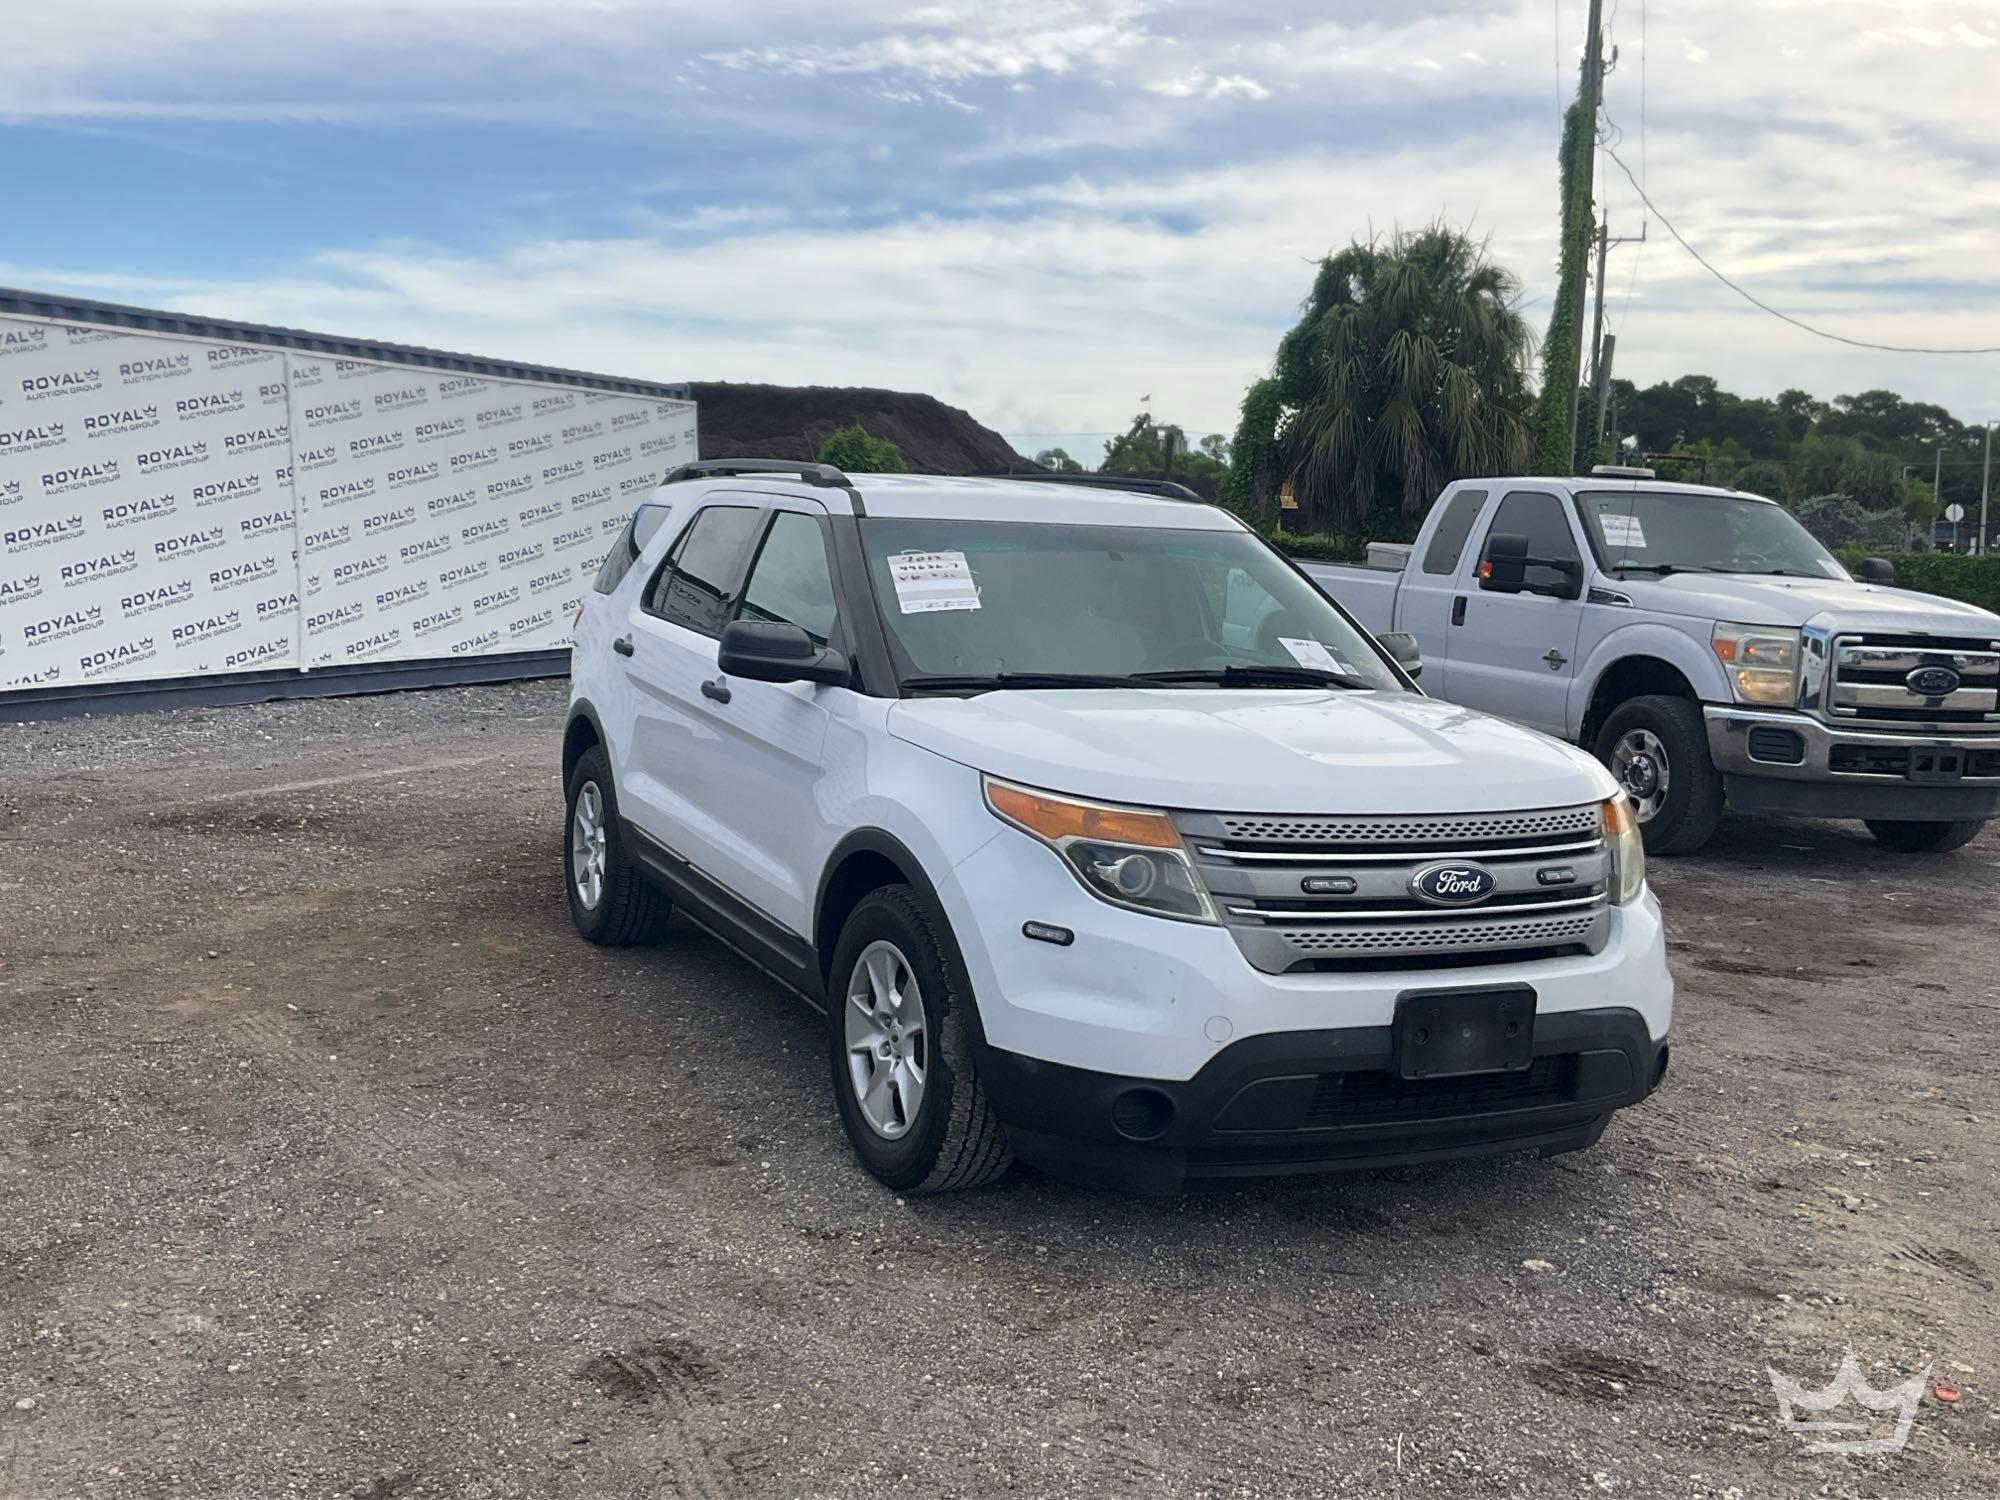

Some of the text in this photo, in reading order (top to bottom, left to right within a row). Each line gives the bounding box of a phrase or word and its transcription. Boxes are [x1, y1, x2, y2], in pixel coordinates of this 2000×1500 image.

[12, 344, 46, 354] GROUP
[120, 358, 176, 376] ROYAL
[22, 373, 84, 392] ROYAL
[124, 368, 192, 385] AUCTION GROUP
[440, 378, 477, 392] ROYAL
[26, 383, 102, 401] AUCTION GROUP
[376, 390, 416, 405] ROYAL
[177, 394, 230, 412] ROYAL
[180, 403, 245, 420] AUCTION GROUP
[305, 403, 350, 419] ROYAL
[533, 396, 566, 409] ROYAL
[85, 410, 143, 429] ROYAL
[477, 408, 512, 422] ROYAL
[612, 412, 641, 425] ROYAL
[89, 420, 160, 438] AUCTION GROUP
[416, 420, 455, 436] ROYAL
[563, 424, 594, 438] ROYAL
[33, 438, 66, 449] GROUP
[225, 429, 275, 447] ROYAL
[228, 438, 290, 455] AUCTION GROUP
[350, 434, 392, 451] ROYAL
[510, 436, 543, 451] ROYAL
[641, 437, 668, 451] ROYAL
[138, 446, 193, 466] ROYAL
[142, 455, 209, 474] AUCTION GROUP
[452, 450, 488, 466] ROYAL
[594, 450, 623, 464] ROYAL
[42, 465, 103, 486] ROYAL
[389, 465, 428, 482] ROYAL
[543, 463, 575, 478] ROYAL
[46, 474, 120, 495] AUCTION GROUP
[194, 479, 246, 499] ROYAL
[320, 481, 363, 499] ROYAL
[488, 478, 523, 493] ROYAL
[621, 475, 649, 490] ROYAL
[197, 487, 260, 507] AUCTION GROUP
[429, 493, 466, 510] ROYAL
[572, 489, 603, 504] ROYAL
[104, 499, 161, 520] ROYAL
[107, 507, 177, 529] AUCTION GROUP
[520, 504, 553, 520] ROYAL
[241, 511, 290, 531] ROYAL
[364, 510, 405, 528] ROYAL
[4, 521, 67, 544] ROYAL
[244, 526, 278, 539] AUCTION
[463, 521, 499, 538] ROYAL
[553, 529, 585, 545] ROYAL
[8, 530, 85, 553] AUCTION GROUP
[156, 532, 210, 554] ROYAL
[401, 539, 440, 557] ROYAL
[160, 540, 225, 562] AUCTION GROUP
[499, 546, 533, 563] ROYAL
[62, 555, 122, 578] ROYAL
[66, 563, 138, 588] AUCTION GROUP
[210, 562, 261, 584] ROYAL
[334, 558, 376, 578] ROYAL
[441, 564, 478, 583] ROYAL
[214, 569, 276, 592] AUCTION GROUP
[530, 571, 563, 588] ROYAL
[8, 589, 42, 603] GROUP
[122, 586, 178, 609] ROYAL
[377, 584, 417, 604] ROYAL
[475, 590, 510, 609] ROYAL
[126, 593, 194, 618] AUCTION GROUP
[257, 594, 297, 613] ROYA
[260, 607, 293, 621] AUCTION
[307, 606, 351, 628] ROYAL
[414, 611, 452, 631] ROYAL
[510, 614, 543, 632] ROYAL
[24, 612, 86, 638] ROYAL
[28, 620, 104, 647] AUCTION GROUP
[173, 616, 226, 640] ROYAL
[177, 623, 241, 648] AUCTION GROUP
[348, 633, 390, 654] ROYAL
[452, 634, 489, 654] ROYAL
[81, 643, 140, 669] ROYAL
[85, 650, 156, 678] AUCTION GROUP
[227, 643, 277, 667] ROYAL
[1436, 870, 1480, 894] Ford
